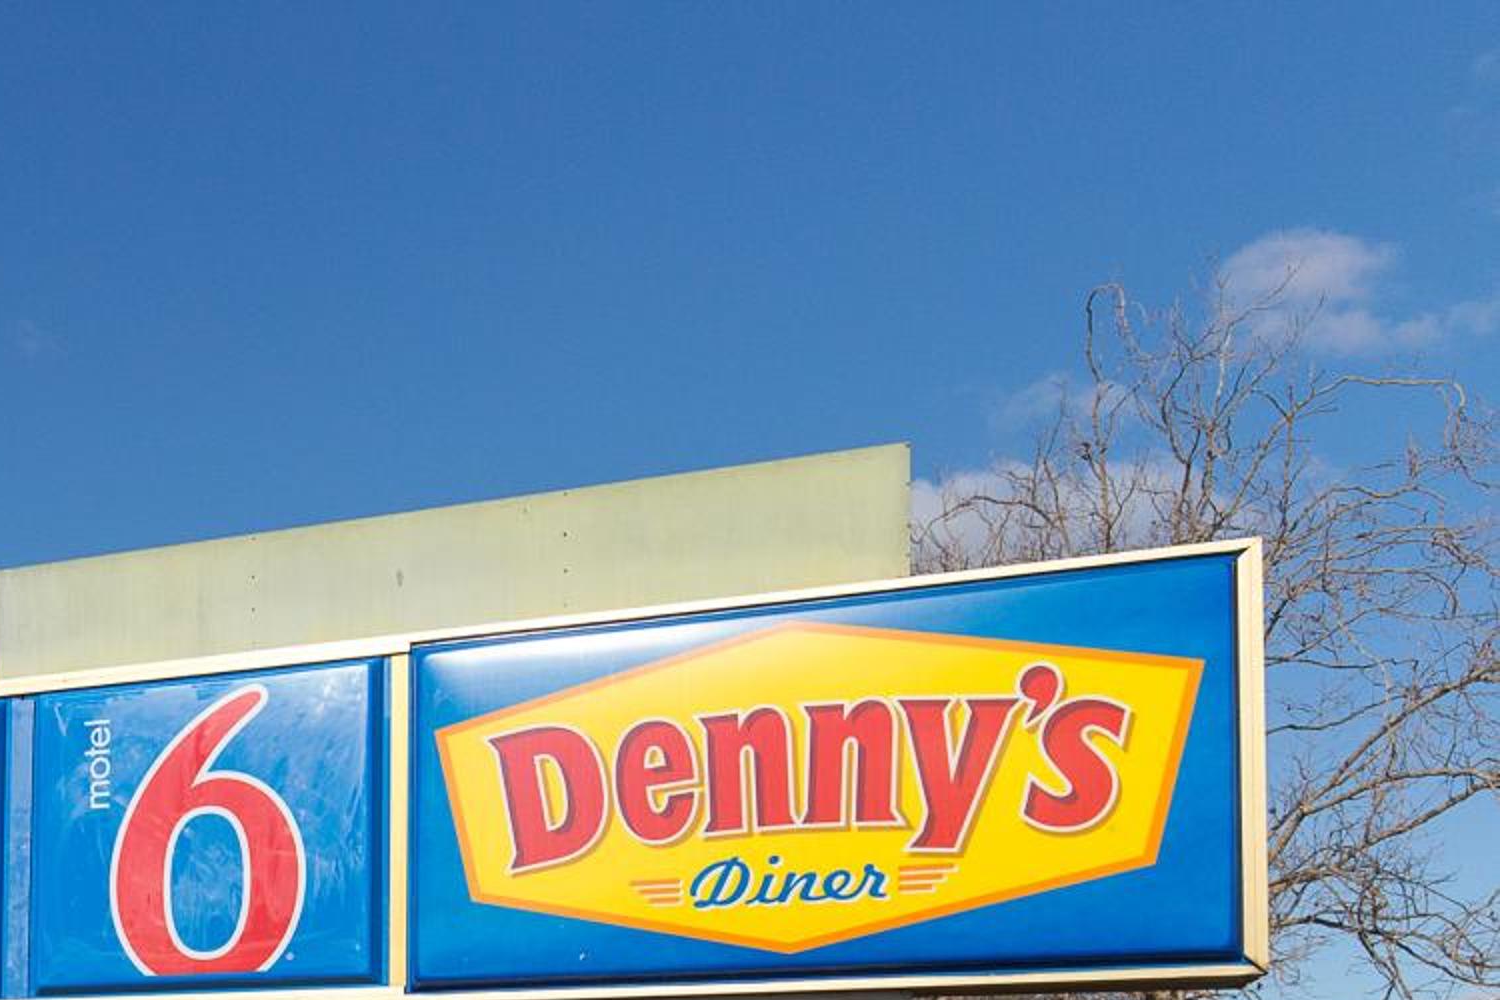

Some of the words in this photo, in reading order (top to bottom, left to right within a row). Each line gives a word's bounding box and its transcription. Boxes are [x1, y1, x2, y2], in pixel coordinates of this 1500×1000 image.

[89, 718, 111, 810] motel
[108, 681, 307, 977] 6
[488, 661, 1133, 876] Denny's
[690, 854, 888, 909] Diner
